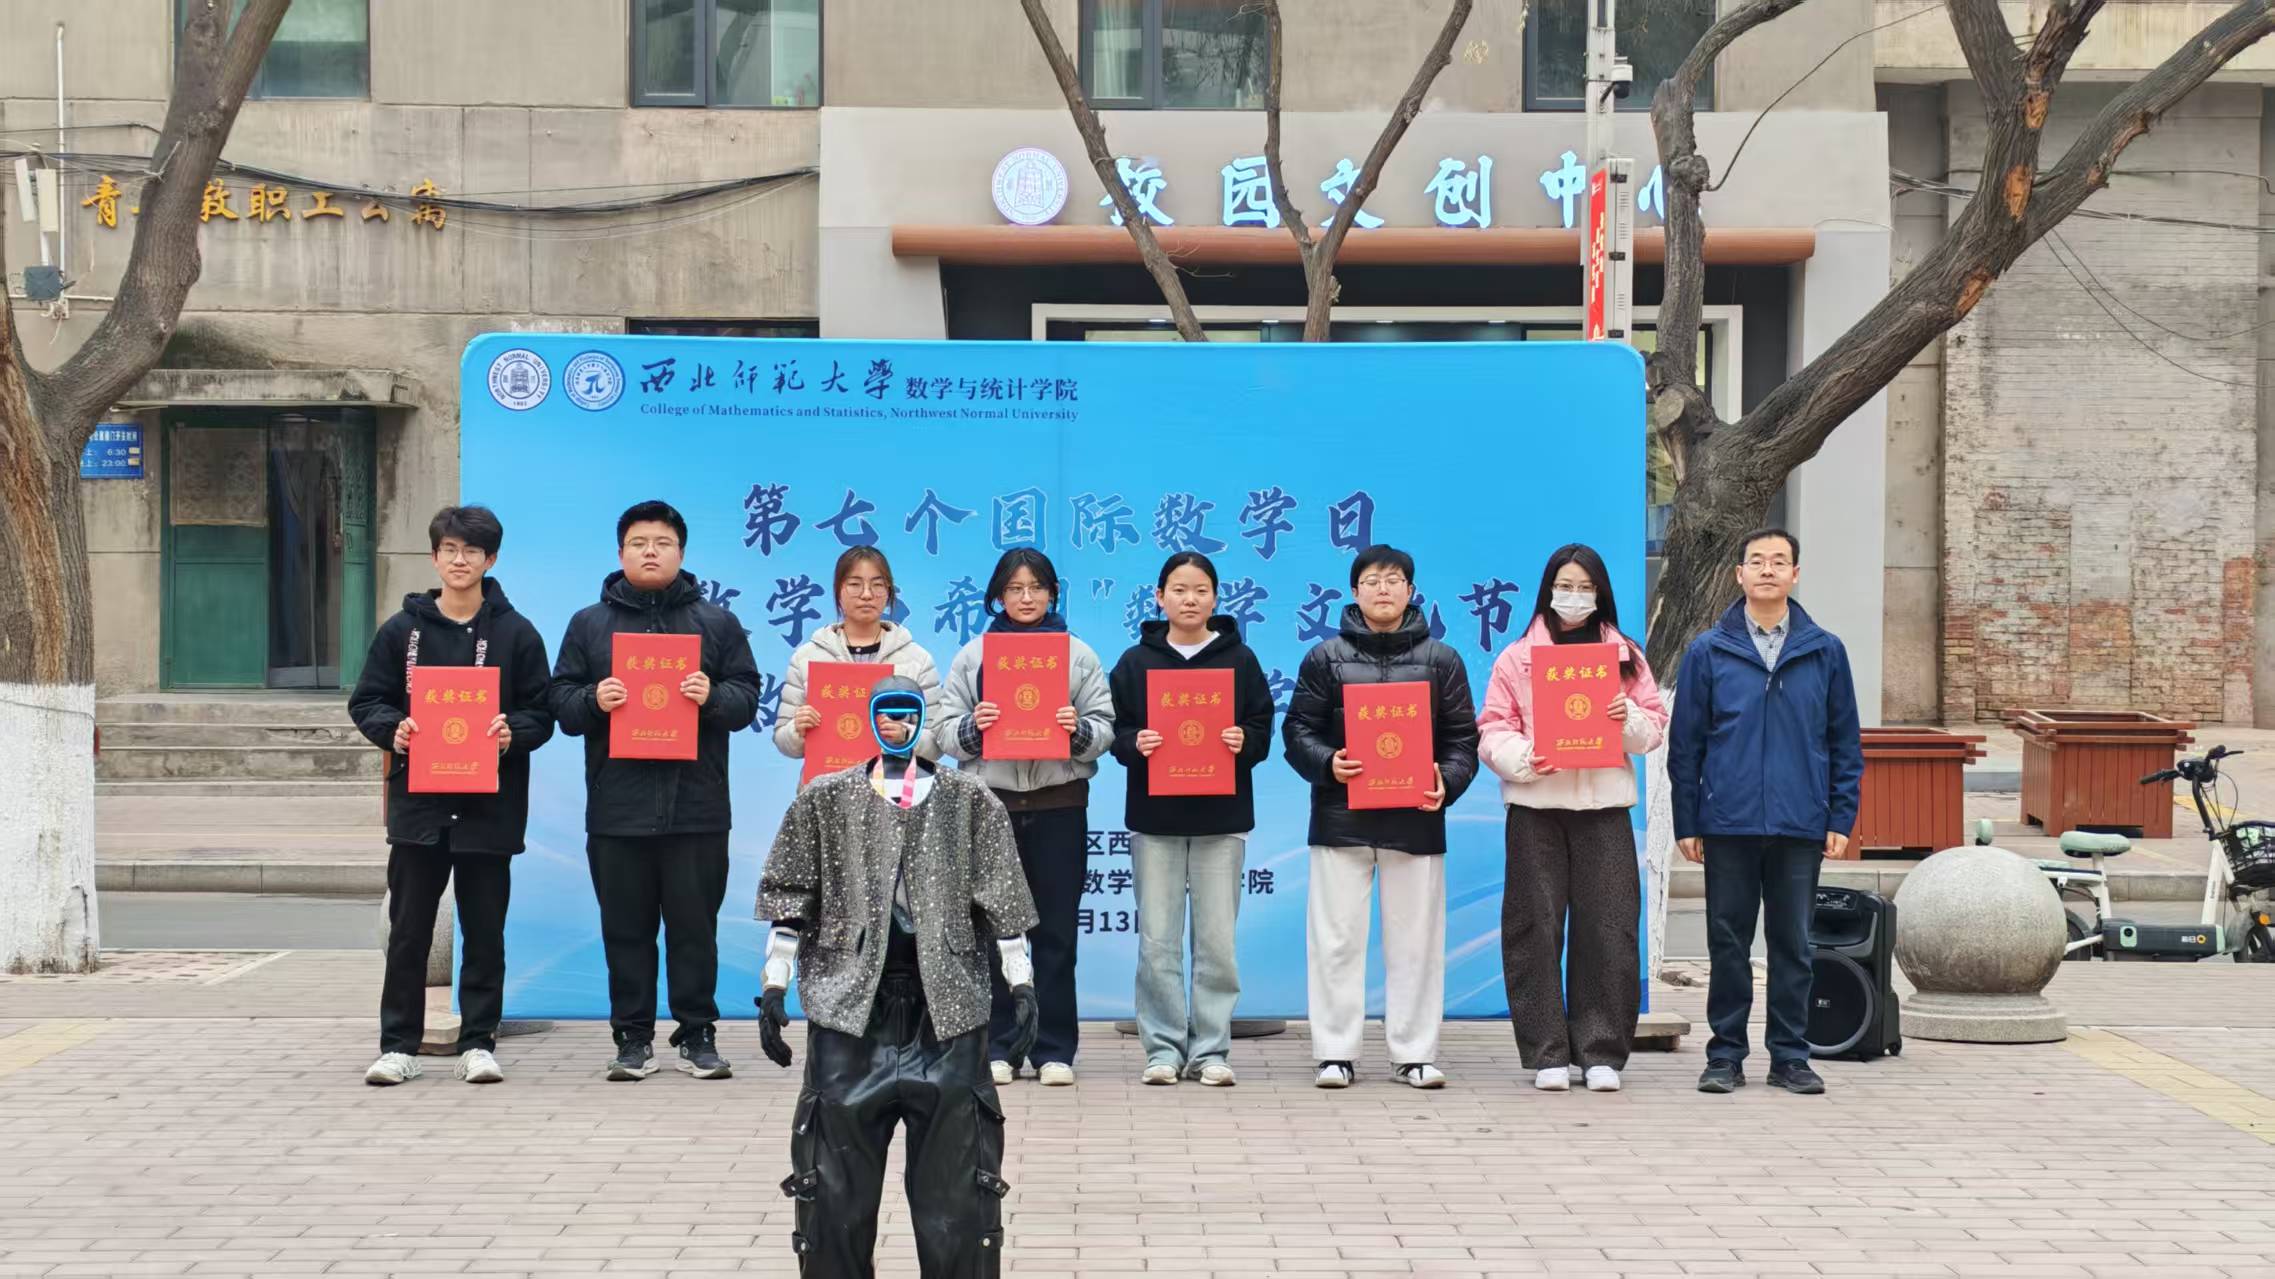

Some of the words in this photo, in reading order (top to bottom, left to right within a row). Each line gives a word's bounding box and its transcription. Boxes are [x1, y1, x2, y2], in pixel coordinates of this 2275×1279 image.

[81, 175, 447, 230] 青教职工公寓
[906, 377, 1078, 401] 数学与统计学院
[640, 404, 689, 416] College
[692, 404, 707, 415] of
[708, 404, 793, 417] Mathematics
[796, 405, 820, 417] and
[823, 406, 887, 419] Statistics,
[891, 407, 957, 418] Northwest
[961, 407, 1008, 419] Normal
[1012, 407, 1078, 422] University
[743, 483, 1378, 560] 第七个国际数学日
[624, 655, 688, 671] 获奖证书
[997, 655, 1058, 671] 获奖证书
[1546, 664, 1608, 682] 获奖证书
[424, 688, 488, 705] 获奖证书
[821, 683, 868, 699] 获奖证
[1358, 703, 1418, 720] 获奖证书
[1077, 908, 1139, 934] 月13
